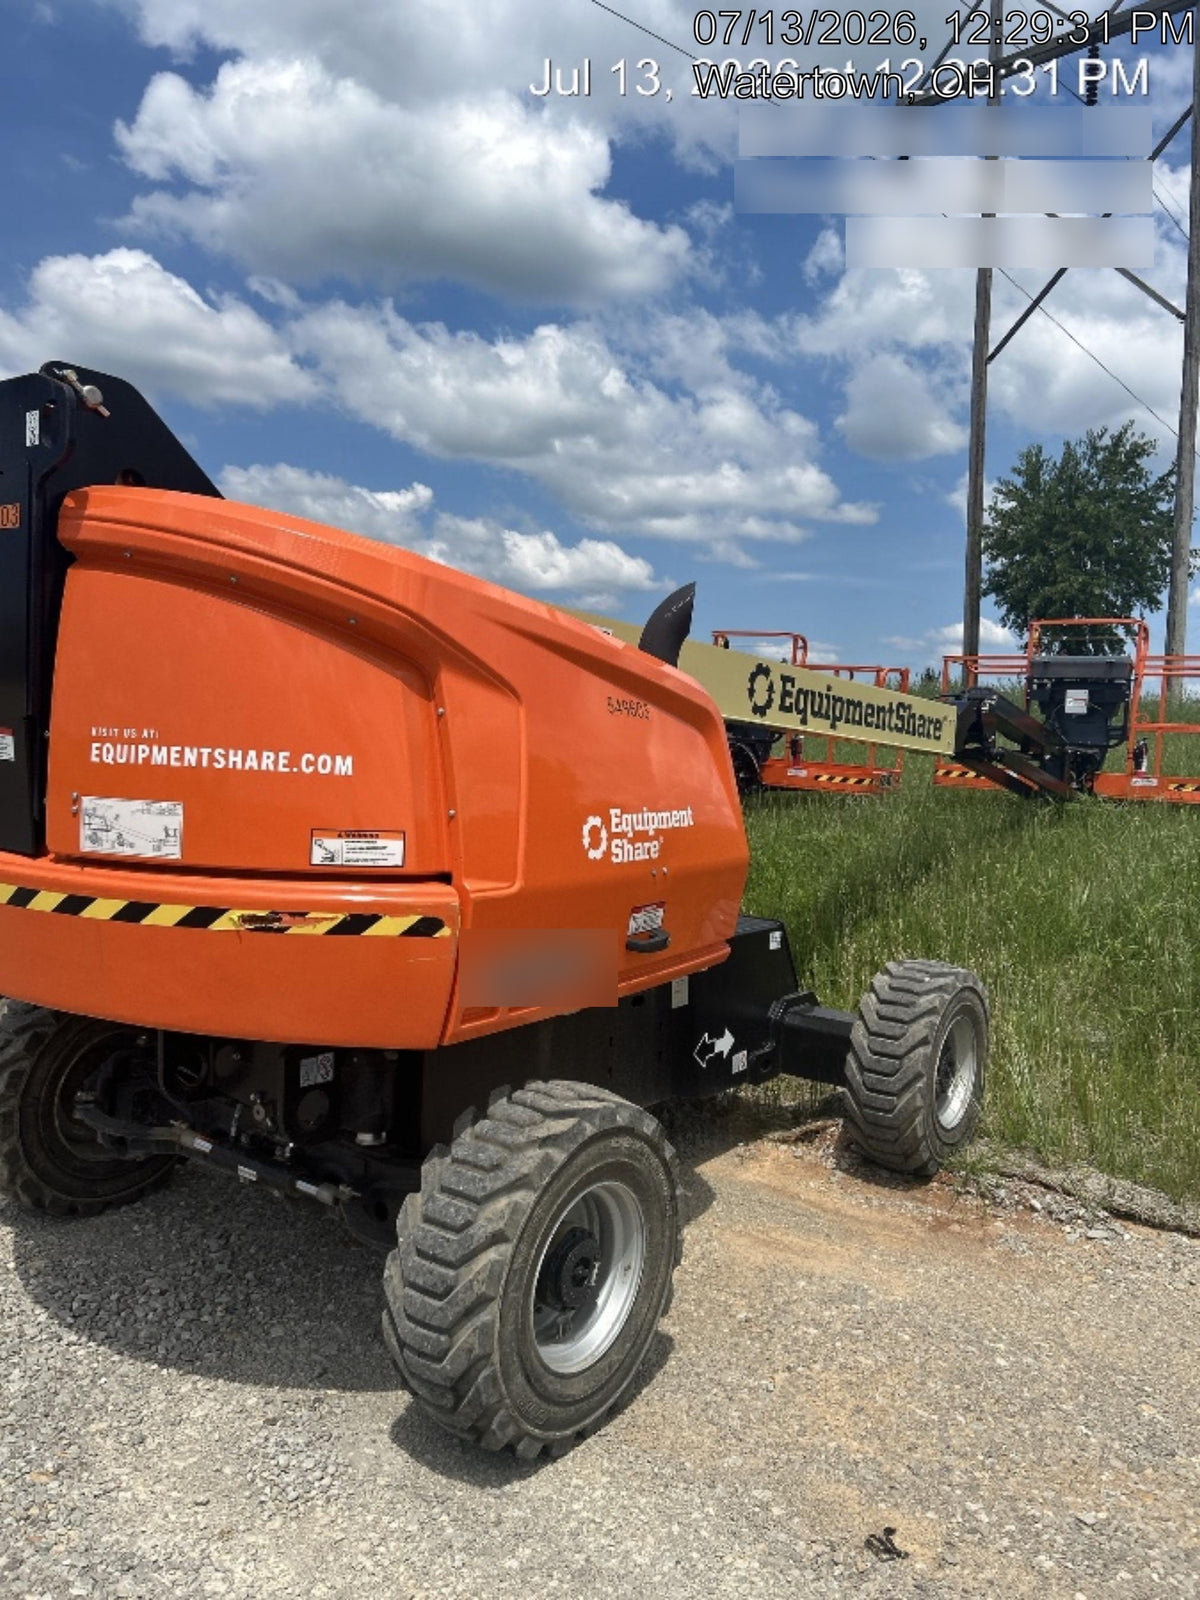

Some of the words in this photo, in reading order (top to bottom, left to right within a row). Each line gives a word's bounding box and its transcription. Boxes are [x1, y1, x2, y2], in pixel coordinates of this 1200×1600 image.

[778, 673, 943, 741] EquipmentShare
[91, 726, 119, 738] VISIT
[123, 728, 137, 739] US
[90, 742, 353, 776] EQUIPMENTSHARE.COM
[609, 805, 694, 838] Equipment
[611, 838, 660, 863] Share
